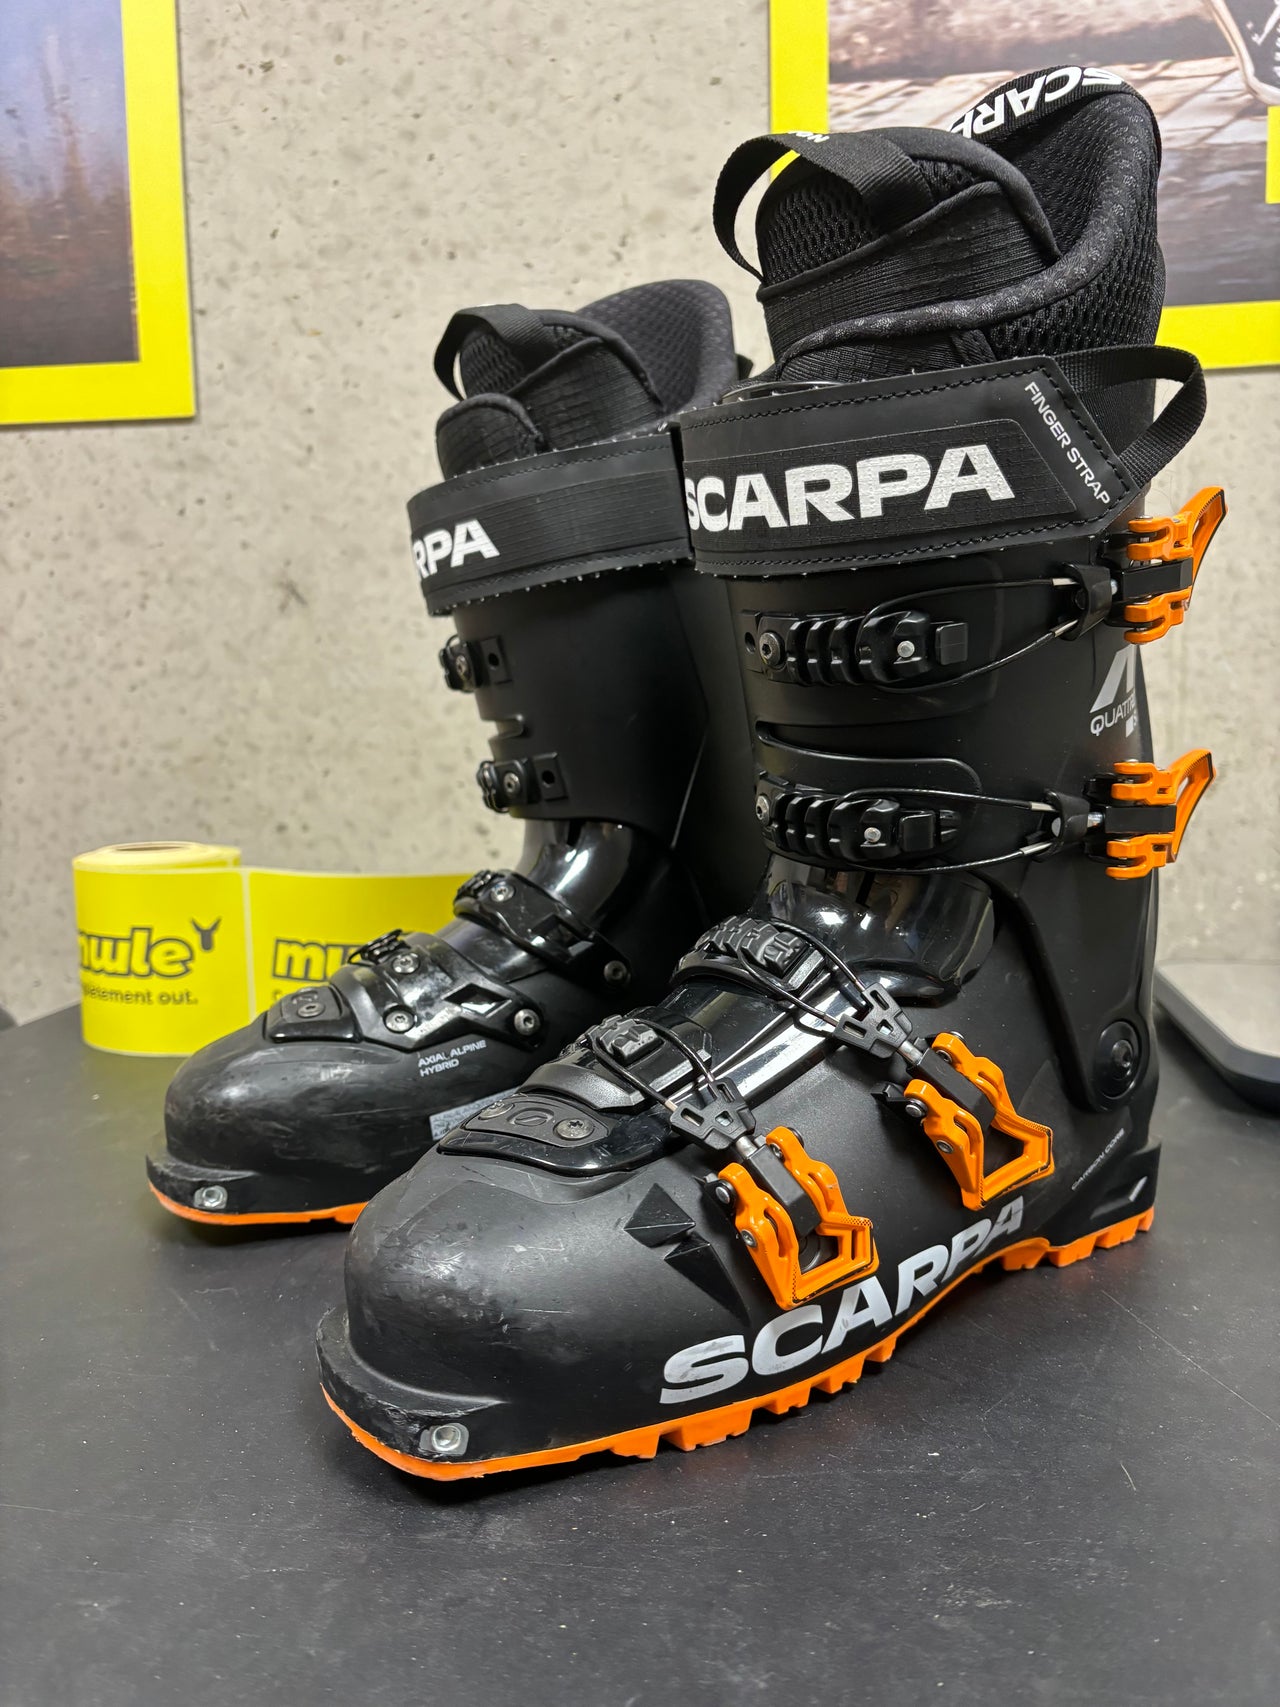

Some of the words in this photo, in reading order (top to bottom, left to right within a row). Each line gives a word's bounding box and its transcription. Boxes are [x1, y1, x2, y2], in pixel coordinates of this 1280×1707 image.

[1024, 381, 1072, 449] FINGER
[1066, 447, 1111, 505] STRAP
[684, 443, 1016, 533] SCARPA
[158, 988, 199, 1006] out.
[419, 1058, 460, 1078] HYBRID
[450, 1039, 487, 1058] ALPINE
[659, 1195, 1024, 1405] SCARPA
